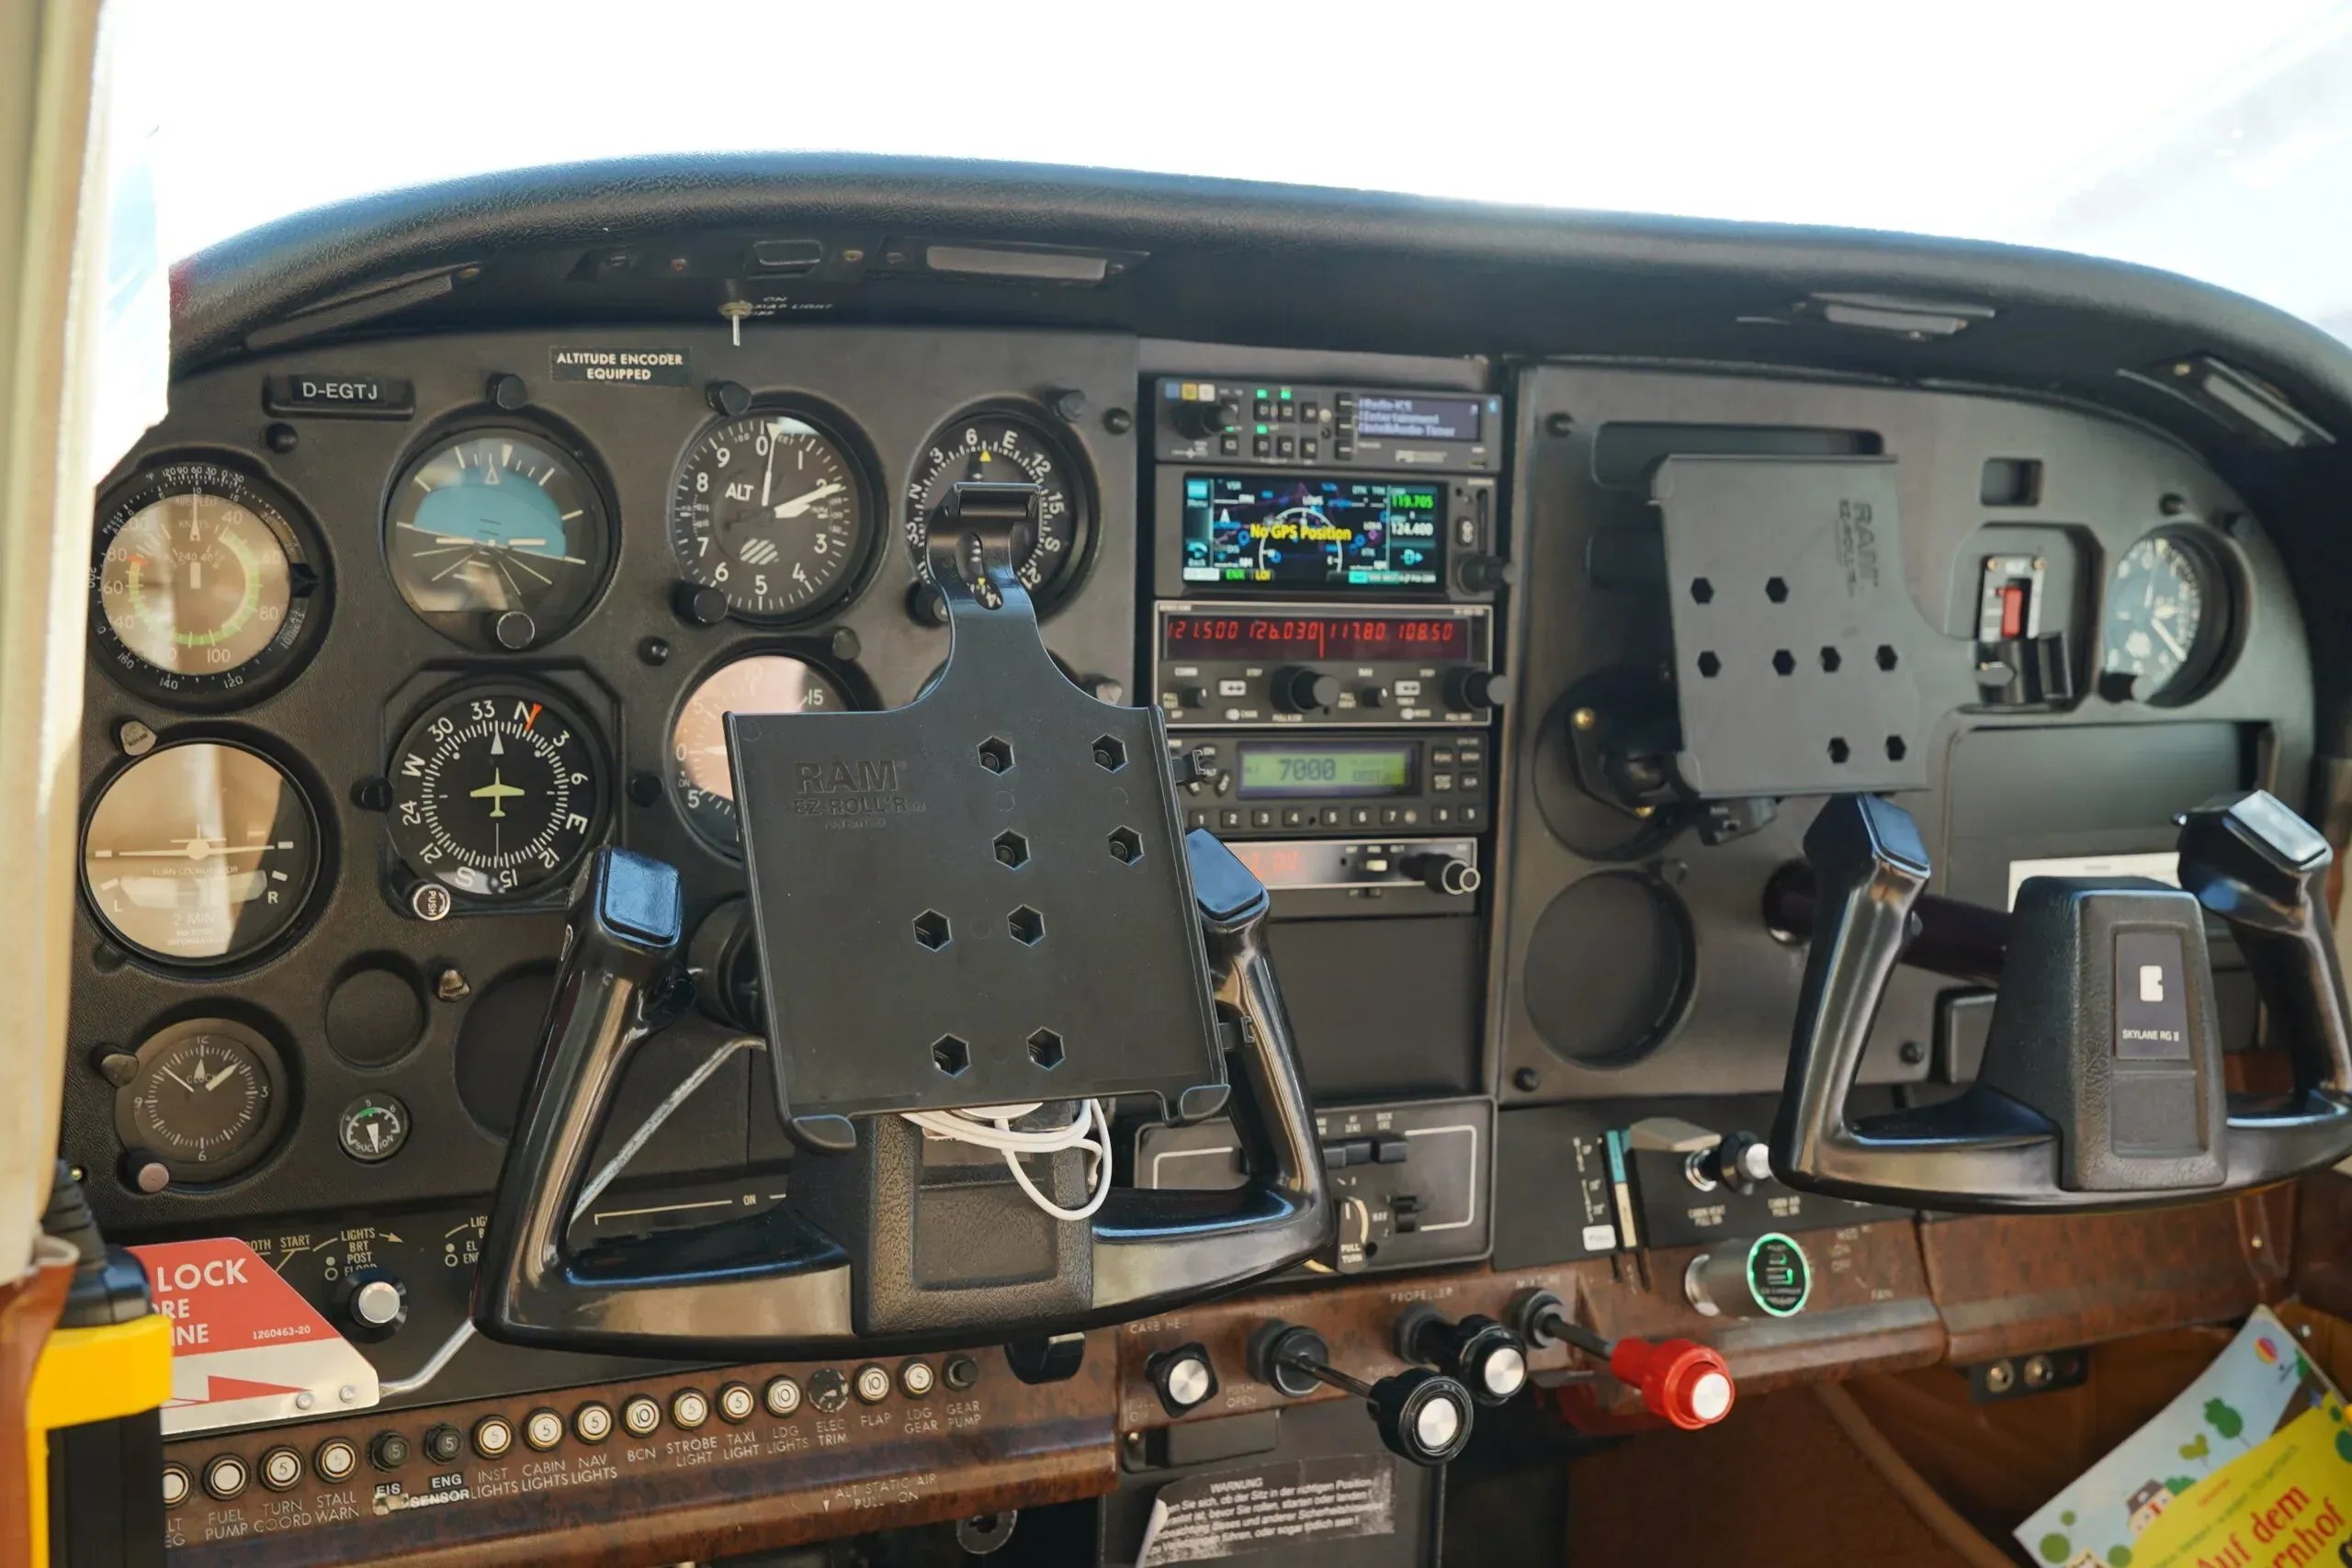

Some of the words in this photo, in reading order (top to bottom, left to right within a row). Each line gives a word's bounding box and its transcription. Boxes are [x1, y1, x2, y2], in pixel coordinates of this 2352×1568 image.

[557, 352, 616, 366] ALTITUDE
[619, 353, 684, 366] ENCODER
[586, 368, 651, 381] EQUIPPED
[301, 381, 379, 401] D-EGTJ
[966, 428, 978, 446] 6
[1002, 430, 1018, 450] E
[755, 435, 769, 457] 0
[716, 446, 730, 468] 9
[797, 449, 804, 470] 1
[929, 447, 944, 464] 3
[1031, 452, 1052, 478] 12
[695, 471, 709, 493] 8
[724, 482, 754, 502] ALT
[908, 483, 922, 500] N
[1047, 491, 1066, 514] 15
[905, 521, 920, 545] 33
[1250, 523, 1269, 539] No
[1271, 523, 1298, 539] GPS
[1300, 525, 1352, 541] Position
[696, 536, 709, 558] 7
[814, 533, 828, 554] 3
[1045, 537, 1061, 552] S
[715, 561, 729, 582] 6
[791, 562, 807, 582] 4
[753, 574, 768, 595] 5
[1330, 622, 1386, 640] 117.80
[1397, 622, 1453, 641] 108.50
[808, 689, 824, 705] 15
[470, 700, 496, 720] 33
[427, 716, 454, 742] 30
[553, 729, 571, 748] 3
[401, 753, 425, 777] W
[1278, 758, 1337, 781] 7000
[571, 772, 589, 785] 6
[793, 760, 899, 795] RAM
[688, 789, 701, 809] 5
[399, 799, 422, 826] 24
[1198, 814, 1204, 825] 1
[1229, 813, 1238, 825] 2
[1261, 812, 1269, 824] 3
[1291, 812, 1299, 823] 4
[1329, 811, 1337, 823] 5
[1358, 811, 1366, 822] 6
[1388, 810, 1396, 822] 7
[565, 812, 589, 834] E
[419, 842, 443, 864] 21
[537, 847, 560, 869] 12
[455, 865, 477, 887] S
[500, 869, 519, 888] 15
[114, 899, 123, 913] L
[267, 891, 278, 904] R
[427, 889, 437, 917] PUSH
[2122, 1028, 2159, 1041] SKYLANE
[2159, 1030, 2172, 1042] RG
[260, 1086, 268, 1098] 3
[356, 1134, 394, 1153] SUCION
[198, 1150, 207, 1162] 6
[742, 1194, 757, 1206] ON
[280, 1234, 311, 1248] START
[340, 1226, 376, 1242] LIGHTS
[348, 1240, 369, 1253] BRT
[346, 1251, 373, 1265] POST
[1341, 1253, 1363, 1264] TURN
[157, 1258, 249, 1292] LOCK
[253, 1325, 311, 1340] 1260463-20
[1129, 1321, 1160, 1335] CARB
[866, 1377, 882, 1391] 10
[734, 1395, 743, 1408] 5
[775, 1389, 791, 1403] 10
[634, 1408, 651, 1425] 10
[906, 1407, 933, 1422] LDG
[945, 1401, 980, 1416] GEAR
[591, 1416, 600, 1428] 5
[816, 1418, 845, 1433] ELEC
[860, 1412, 892, 1428] FLAP
[905, 1418, 939, 1435] GEAR
[947, 1413, 982, 1428] PUMP
[542, 1424, 551, 1437] 5
[726, 1430, 756, 1446] TAXI
[773, 1425, 799, 1439] LDG
[445, 1437, 454, 1450] 5
[667, 1436, 718, 1455] STROBE
[767, 1438, 809, 1455] LIGHTS
[818, 1432, 849, 1448] TRIM
[391, 1444, 401, 1459] 5
[627, 1448, 657, 1462] BCN
[675, 1450, 714, 1468] LIGHT
[723, 1444, 760, 1461] LIGHT
[278, 1462, 288, 1476] 5
[522, 1461, 566, 1477] CABIN
[578, 1453, 607, 1470] NAV
[431, 1473, 463, 1489] ENG
[478, 1468, 508, 1483] INST
[522, 1473, 569, 1493] LIGHTS
[571, 1467, 618, 1485] LIGHTS
[375, 1483, 401, 1496] EIS
[470, 1481, 519, 1500] LIGHTS
[834, 1484, 859, 1500] ALT
[865, 1476, 910, 1495] STATIC
[916, 1472, 938, 1486] AIR
[1210, 1477, 1264, 1494] WARNUNG
[316, 1490, 357, 1508] STALL
[409, 1488, 470, 1508] SENSOR
[854, 1495, 885, 1511] PULL
[898, 1490, 920, 1504] ON
[263, 1499, 303, 1516] TURN
[314, 1506, 360, 1523] WARN
[2250, 1484, 2311, 1544] dem
[209, 1508, 244, 1526] FUEL
[254, 1512, 312, 1533] COORD
[205, 1521, 248, 1541] PUMP
